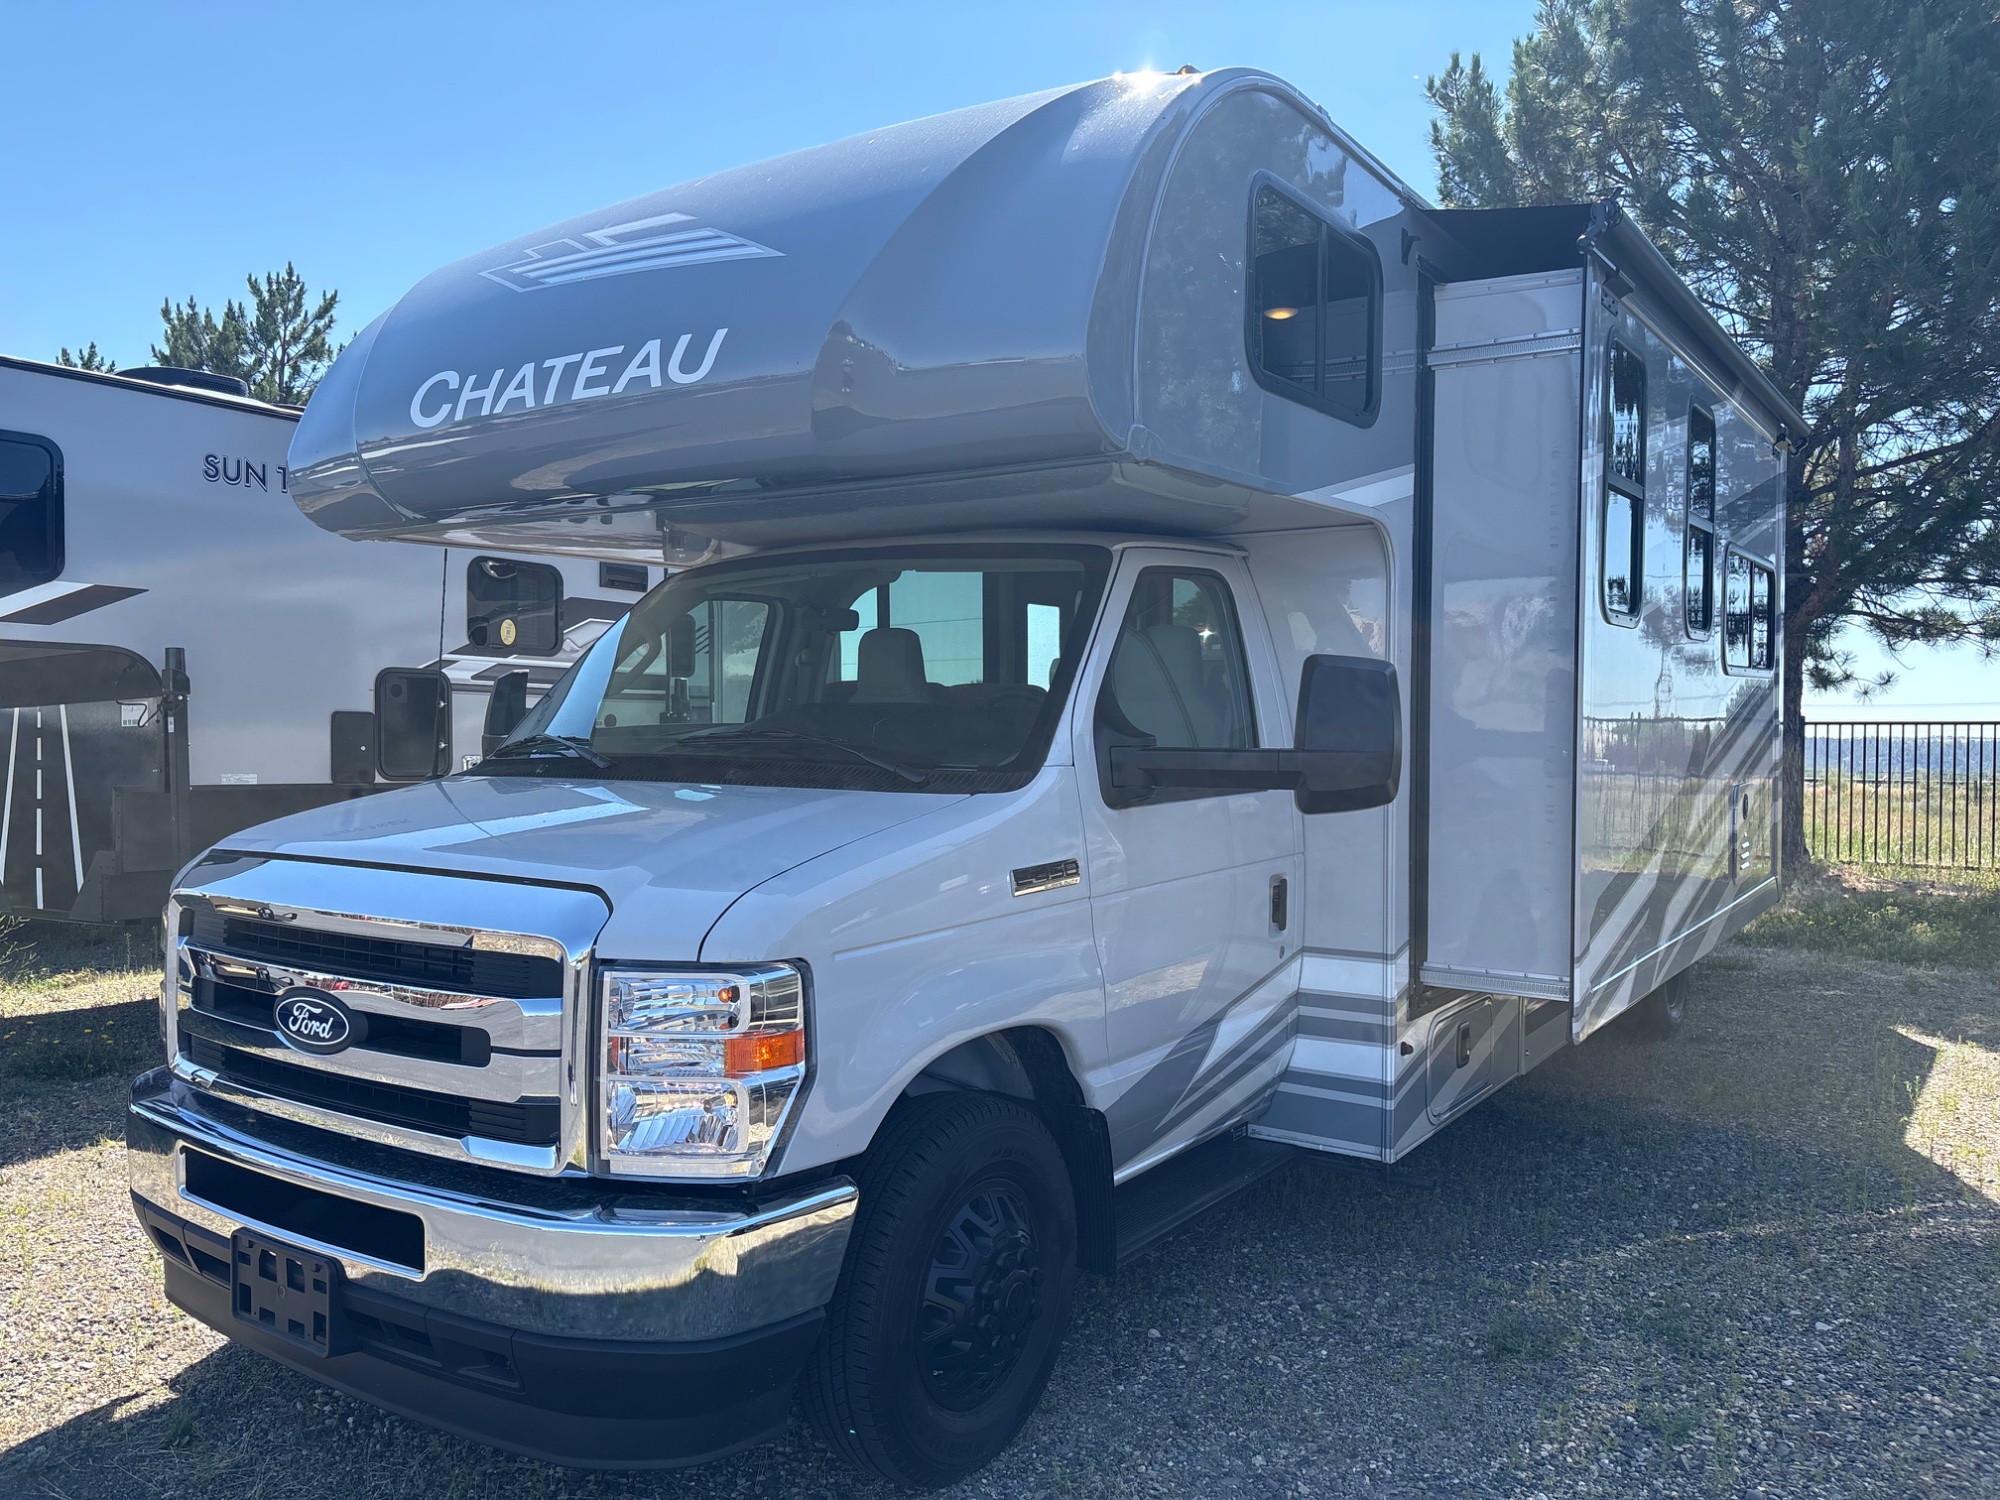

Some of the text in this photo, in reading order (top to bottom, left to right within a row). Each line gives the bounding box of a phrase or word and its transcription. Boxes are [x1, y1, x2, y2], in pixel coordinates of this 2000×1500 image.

[409, 327, 728, 428] CHATEAU
[202, 453, 268, 493] SUN
[288, 1002, 334, 1039] Ford
